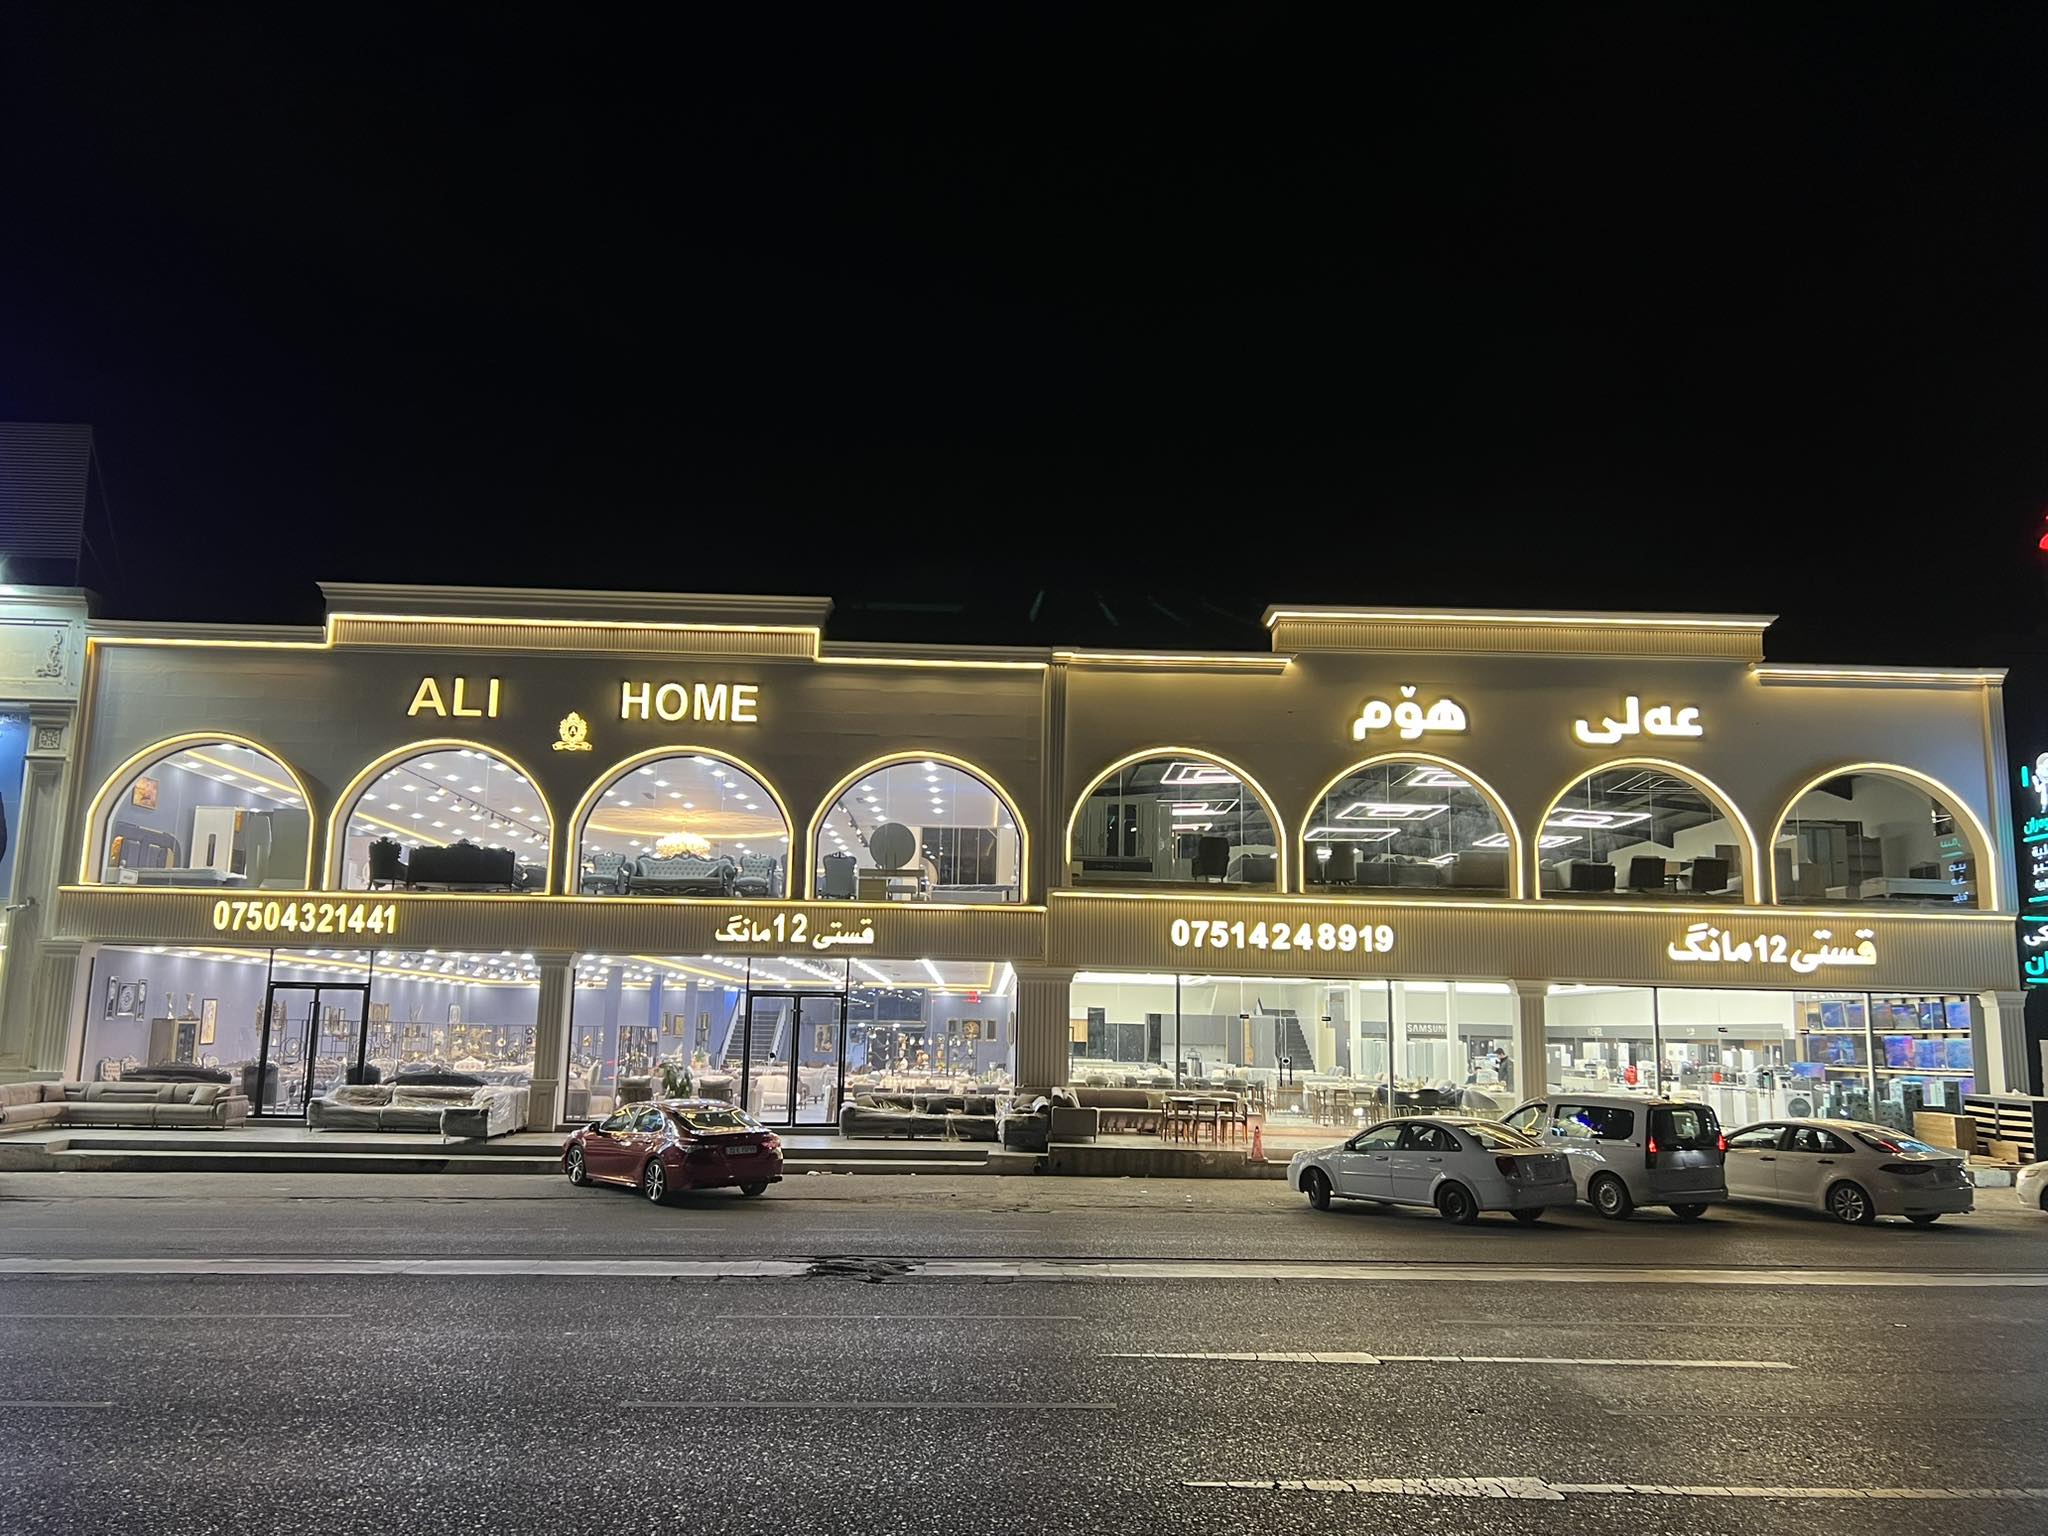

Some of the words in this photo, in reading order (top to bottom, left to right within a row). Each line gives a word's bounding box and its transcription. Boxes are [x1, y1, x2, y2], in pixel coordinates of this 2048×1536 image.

[406, 676, 500, 719] ALI
[620, 680, 760, 724] HOME
[212, 900, 398, 935] 07504321441
[1169, 917, 1395, 954] 07514248919
